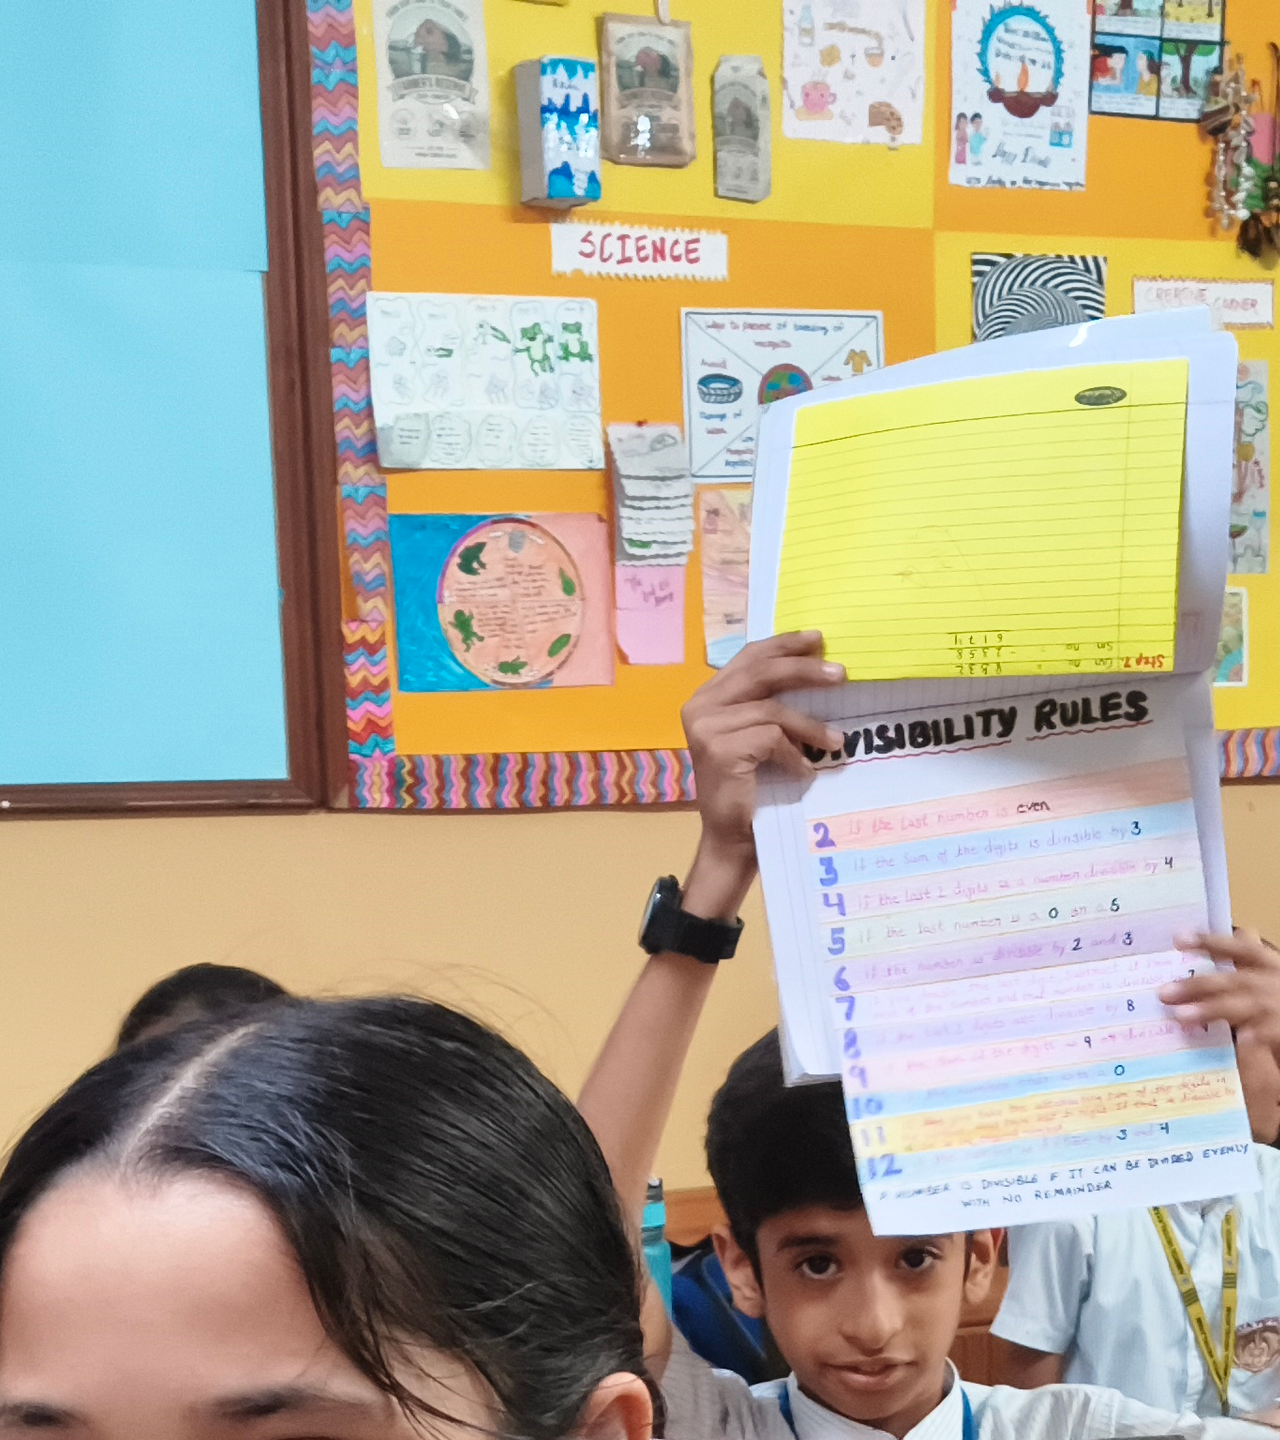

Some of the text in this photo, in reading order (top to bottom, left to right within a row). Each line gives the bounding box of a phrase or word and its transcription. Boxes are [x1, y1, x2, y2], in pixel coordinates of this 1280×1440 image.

[578, 230, 701, 265] SCIENCE
[1034, 690, 1149, 733] RULES
[813, 821, 837, 848] 2
[1016, 800, 1050, 814] even
[819, 856, 839, 887] 3
[1131, 820, 1142, 836] 3
[823, 892, 846, 916] 4
[1164, 855, 1174, 870] 4
[826, 926, 846, 956] 5
[1048, 907, 1059, 919] 0
[834, 964, 851, 992] 6
[1071, 936, 1084, 951] 2
[835, 994, 856, 1022] 7
[1126, 998, 1136, 1012] 8
[849, 1035, 1093, 1089] 9 9
[866, 1152, 904, 1180] 12
[1116, 1128, 1128, 1141] 3
